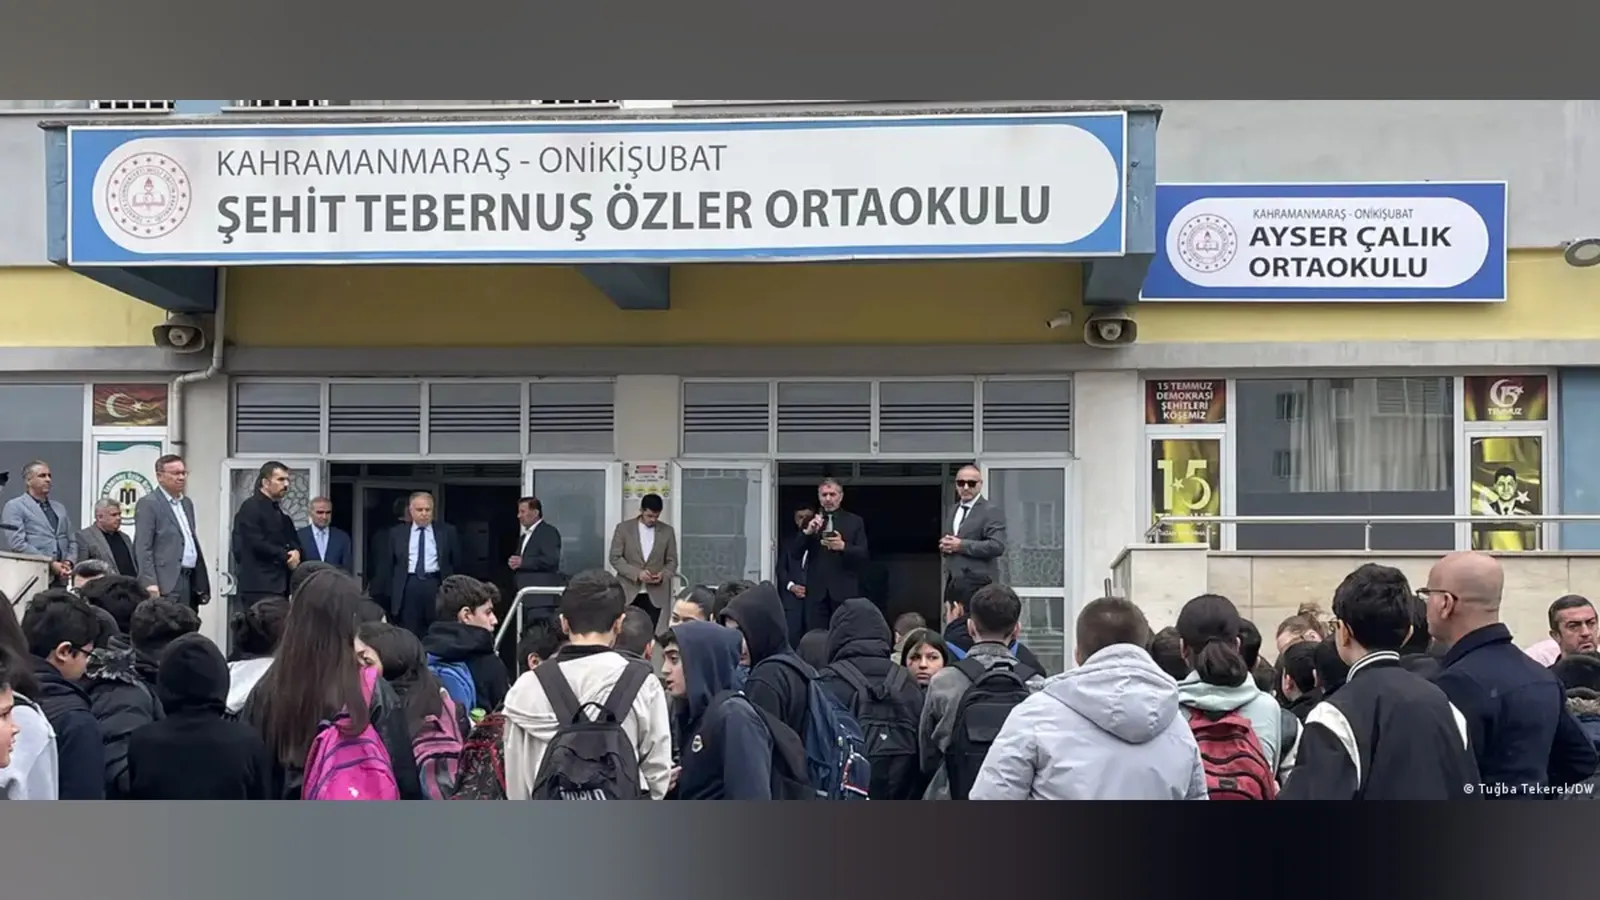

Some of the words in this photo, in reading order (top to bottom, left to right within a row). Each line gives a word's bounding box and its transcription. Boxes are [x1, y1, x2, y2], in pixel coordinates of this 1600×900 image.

[217, 146, 511, 181] KAHRAMANMARAŞ
[538, 140, 728, 179] ONİKİŞUBAT
[216, 186, 346, 244] ŞEHİT
[355, 192, 594, 242] TEBERNUŞ
[606, 182, 753, 231] ÖZLER
[765, 185, 1051, 229] ORTAOKULU
[1253, 208, 1347, 221] KAHRAMANMARAŞ
[1354, 208, 1414, 221] ONİKİŞUBAT
[1249, 226, 1348, 247] AYSER
[1356, 226, 1452, 253] ÇALIK
[1248, 256, 1428, 278] ORTAOKULU
[1157, 381, 1169, 390] 15
[1170, 381, 1213, 391] TEMMUZ
[1156, 390, 1214, 400] DEMOKRASİ
[1160, 400, 1209, 411] ŞEHİTLERİ
[1163, 410, 1207, 421] KÖŞEMİZ
[1157, 459, 1212, 510] 15
